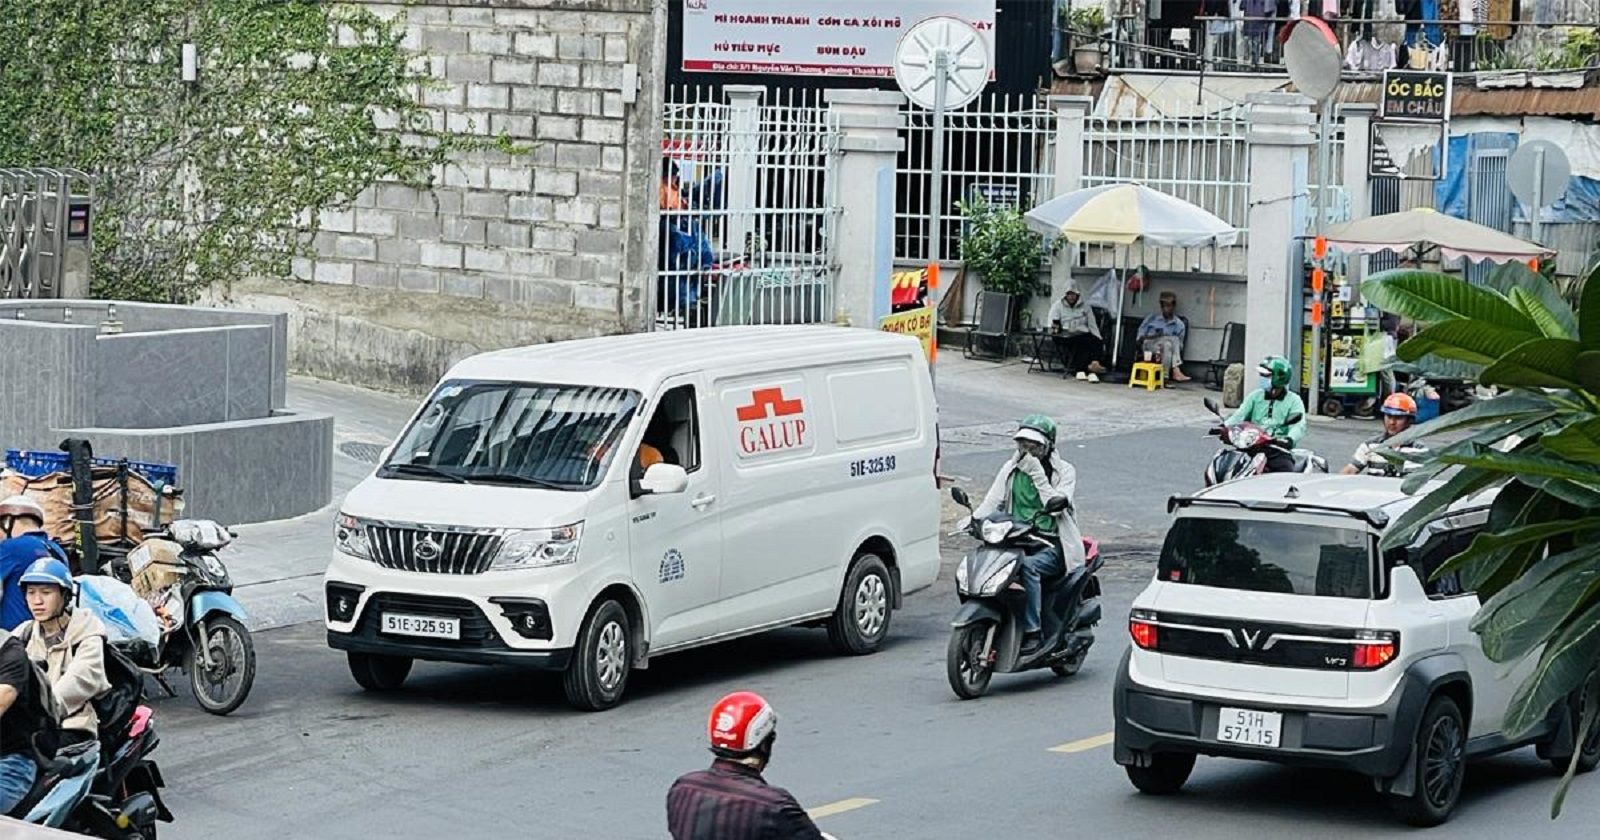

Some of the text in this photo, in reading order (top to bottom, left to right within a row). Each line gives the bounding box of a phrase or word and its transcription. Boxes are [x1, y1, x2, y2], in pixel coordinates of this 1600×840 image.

[1388, 77, 1410, 97] ỐC
[1387, 98, 1442, 115] EM CHÂU
[740, 419, 806, 454] GALUP
[1237, 711, 1264, 728] 51H
[1224, 726, 1273, 745] 571.15
